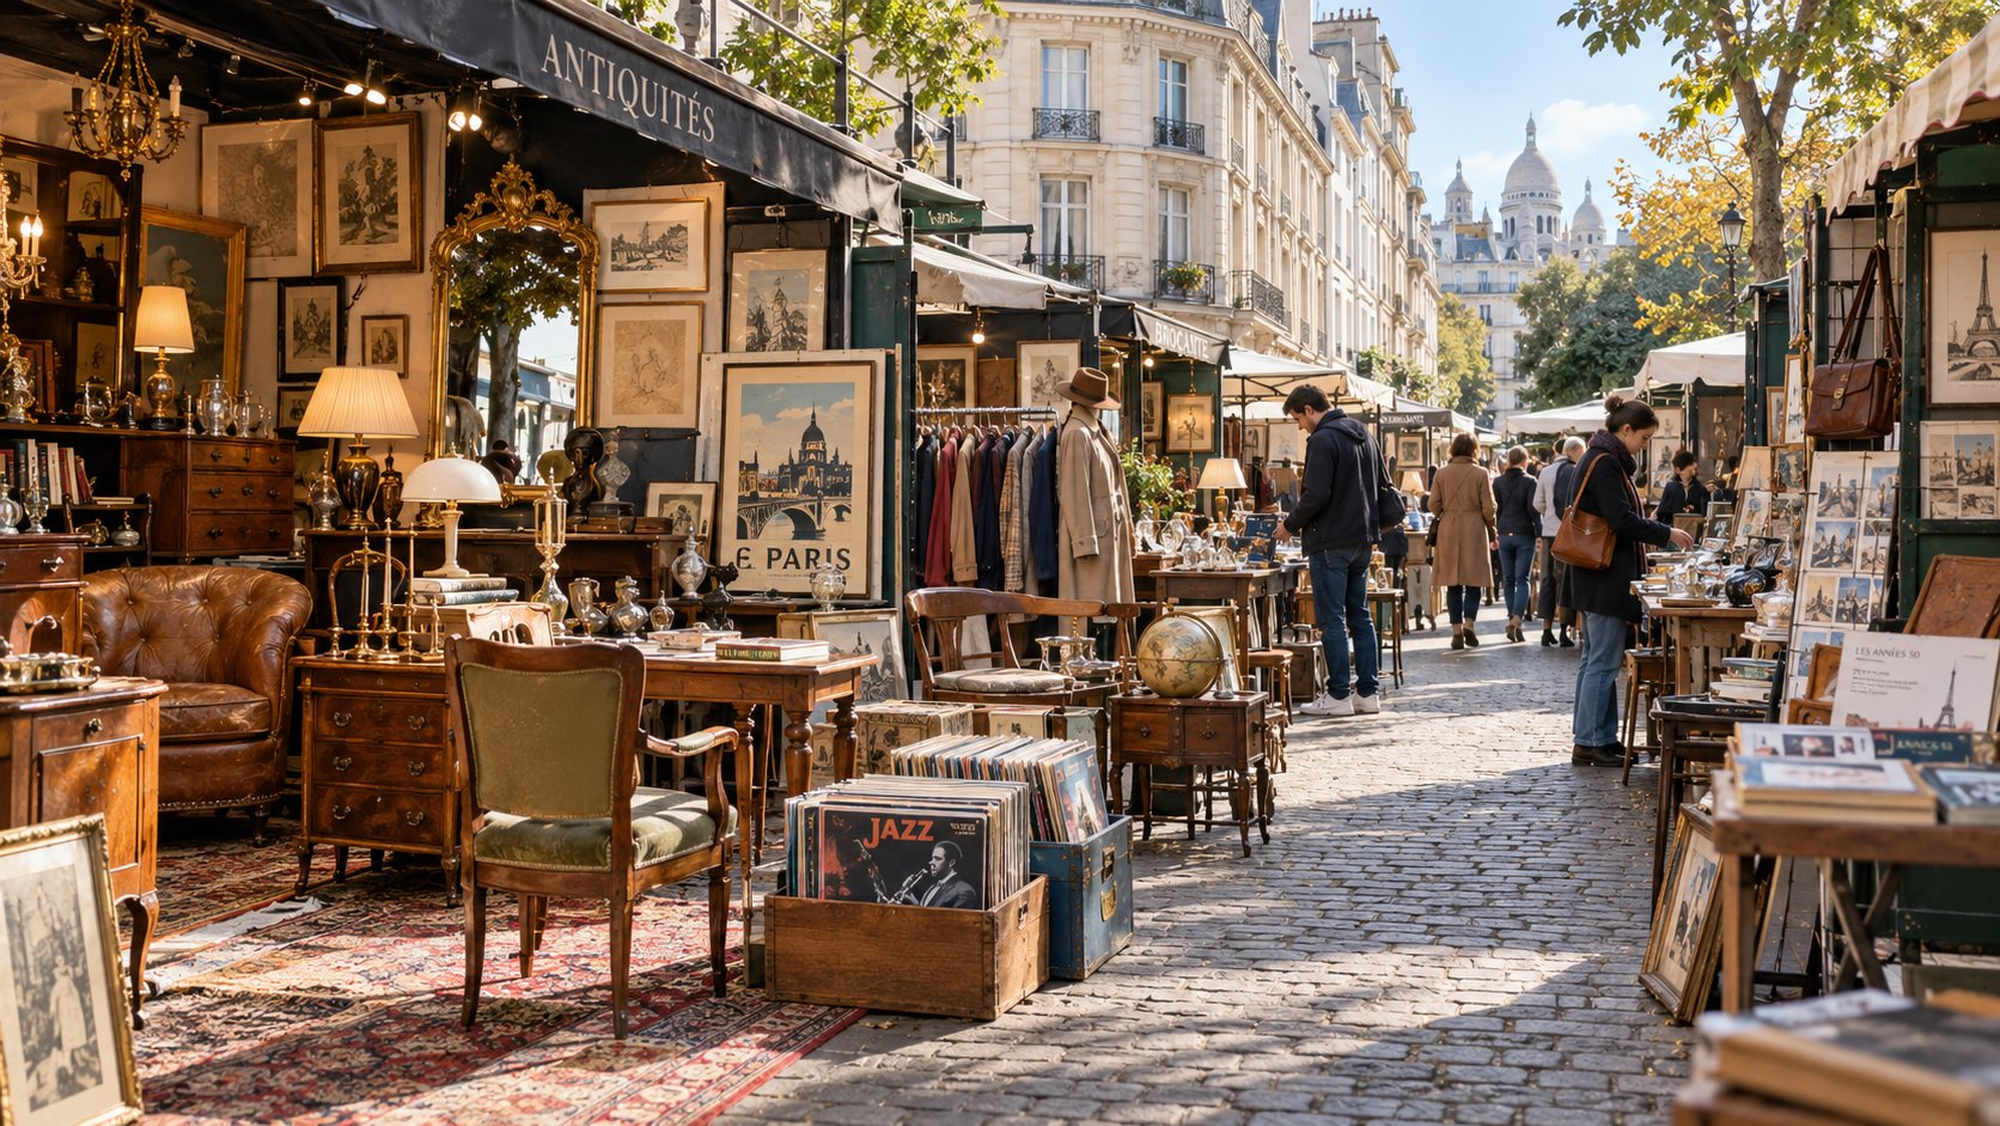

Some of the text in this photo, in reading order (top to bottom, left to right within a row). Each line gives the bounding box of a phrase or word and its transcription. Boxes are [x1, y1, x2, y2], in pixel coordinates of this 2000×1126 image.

[541, 33, 716, 144] ANTIQUITÉS
[767, 547, 850, 570] PARIS
[1855, 647, 1871, 658] LES
[863, 817, 934, 848] JAZZ
